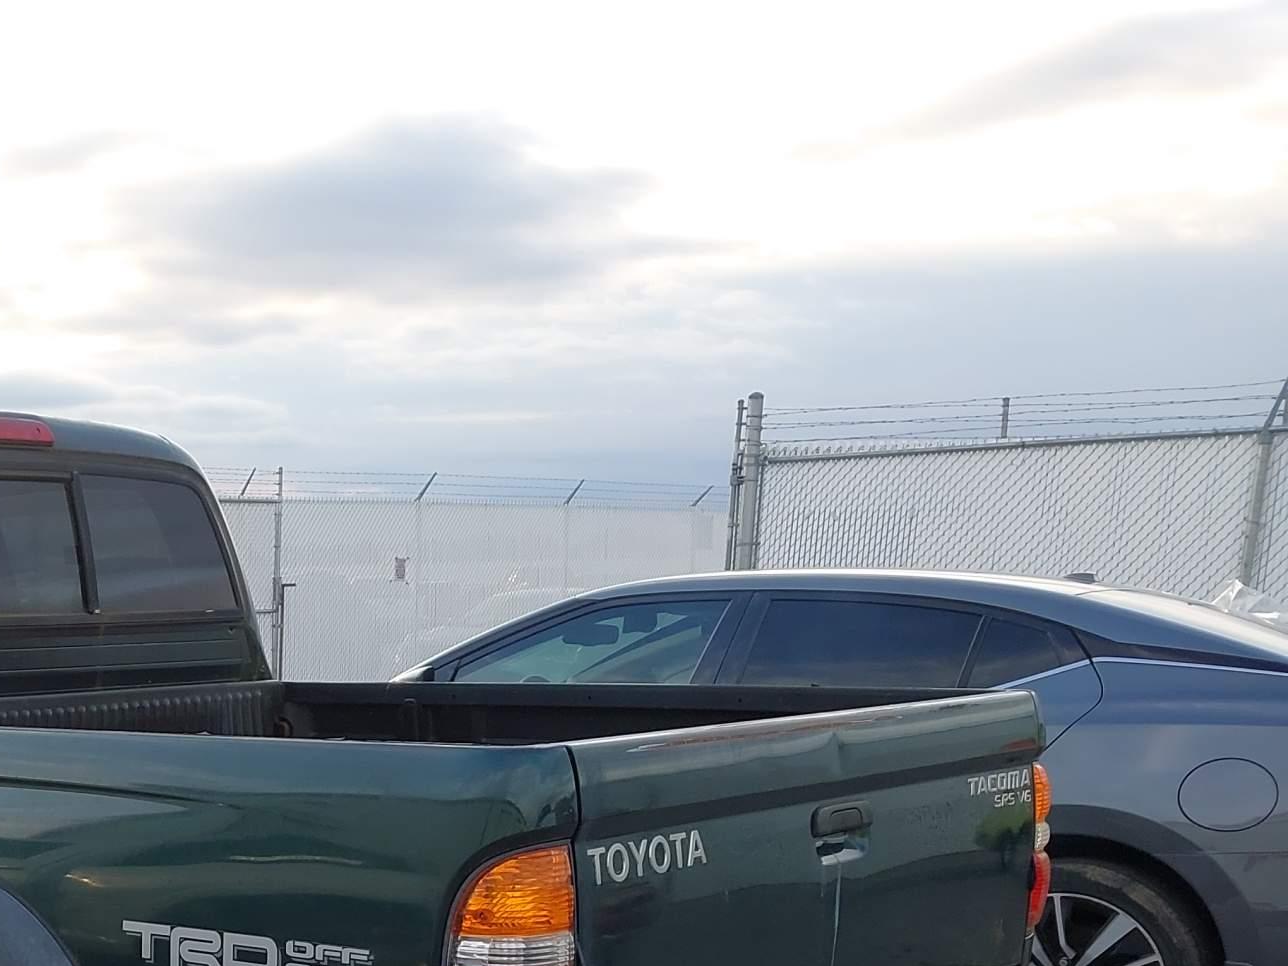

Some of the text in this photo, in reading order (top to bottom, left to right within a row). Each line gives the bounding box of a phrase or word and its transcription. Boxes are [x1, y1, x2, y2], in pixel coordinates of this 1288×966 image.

[967, 769, 1031, 796] TACOMA
[1017, 789, 1032, 803] V6
[587, 829, 707, 885] TOYOTA
[285, 939, 374, 966] OFF
